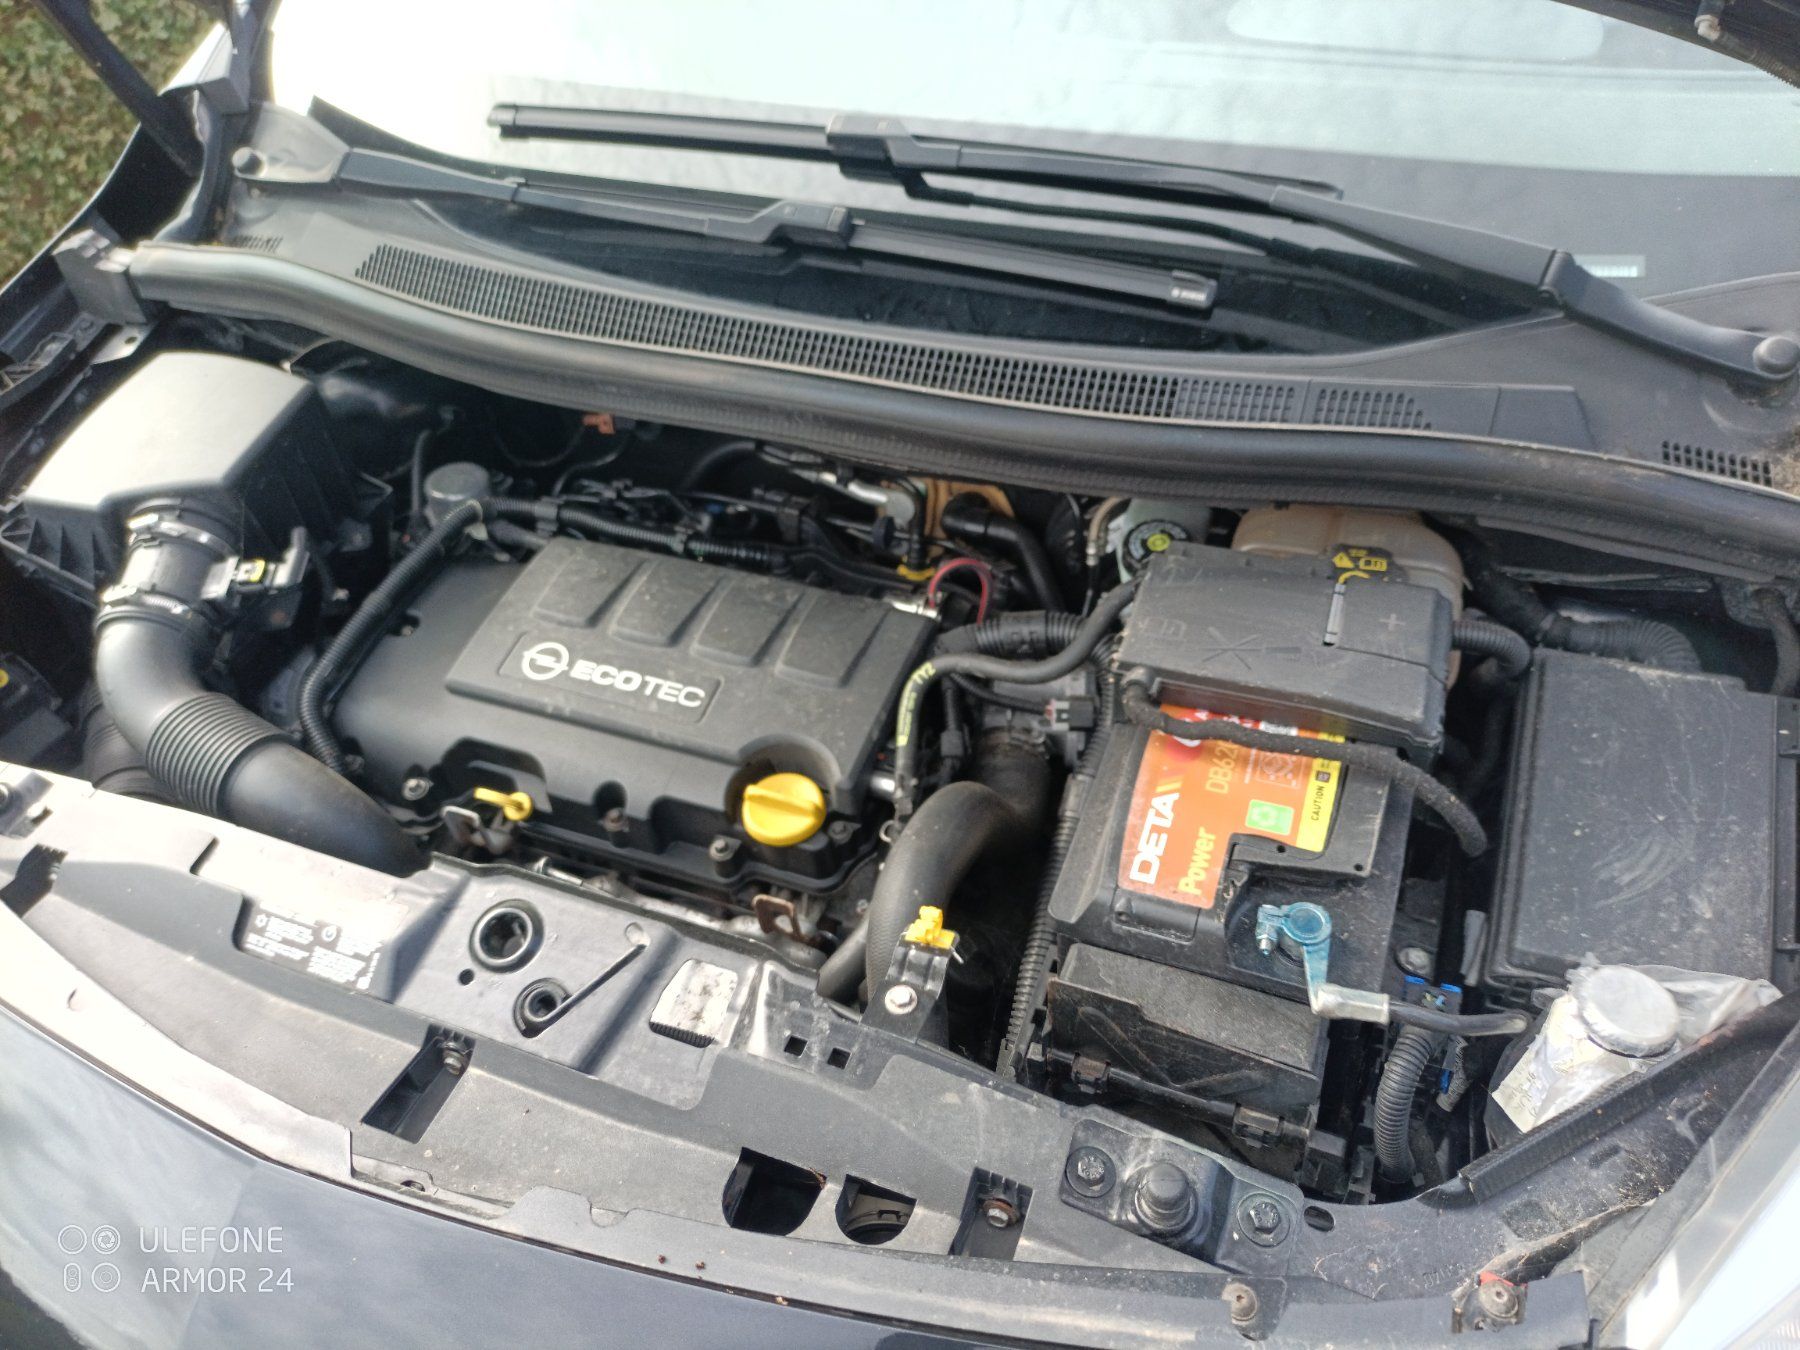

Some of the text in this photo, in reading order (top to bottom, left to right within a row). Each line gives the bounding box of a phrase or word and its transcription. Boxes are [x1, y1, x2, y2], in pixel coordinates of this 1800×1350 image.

[570, 659, 706, 708] ECOTEC
[1311, 785, 1324, 821] CAUTION
[1129, 792, 1180, 885] DETA
[1178, 826, 1216, 896] Power
